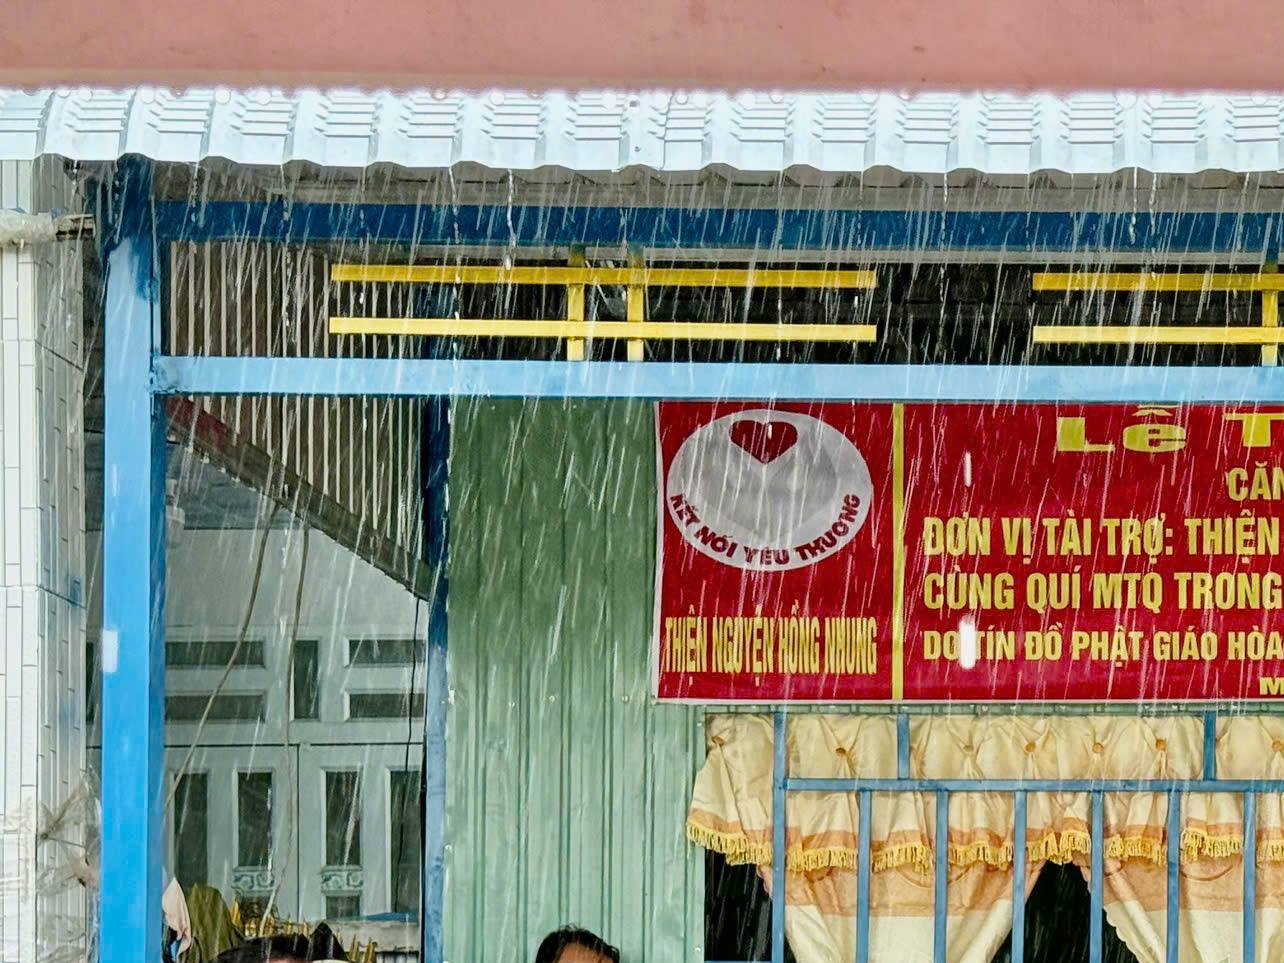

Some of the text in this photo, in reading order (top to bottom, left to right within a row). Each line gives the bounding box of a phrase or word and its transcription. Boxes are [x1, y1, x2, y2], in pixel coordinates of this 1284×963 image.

[1056, 404, 1187, 453] Lễ
[670, 493, 701, 528] KẾT
[694, 525, 739, 558] NỐI
[743, 546, 791, 566] YÊU
[923, 511, 991, 556] ĐƠN
[1001, 516, 1032, 565] VỊ
[1042, 508, 1092, 556] TÀI
[1102, 512, 1174, 565] TRỢ:
[1184, 508, 1280, 565] THIỆN
[924, 564, 1015, 610] CÙNG
[1026, 565, 1081, 614] QUÍ
[1092, 571, 1163, 614] MTQ
[1173, 571, 1283, 610] TRONG
[664, 599, 878, 687] THIỆN NGUYỆN HỒNG NHUNG
[923, 630, 961, 660] DO
[1024, 621, 1063, 662] ĐỒ
[1071, 624, 1145, 668] PHẬT
[1152, 625, 1218, 661] GIÁO
[1227, 624, 1284, 661] HÒA
